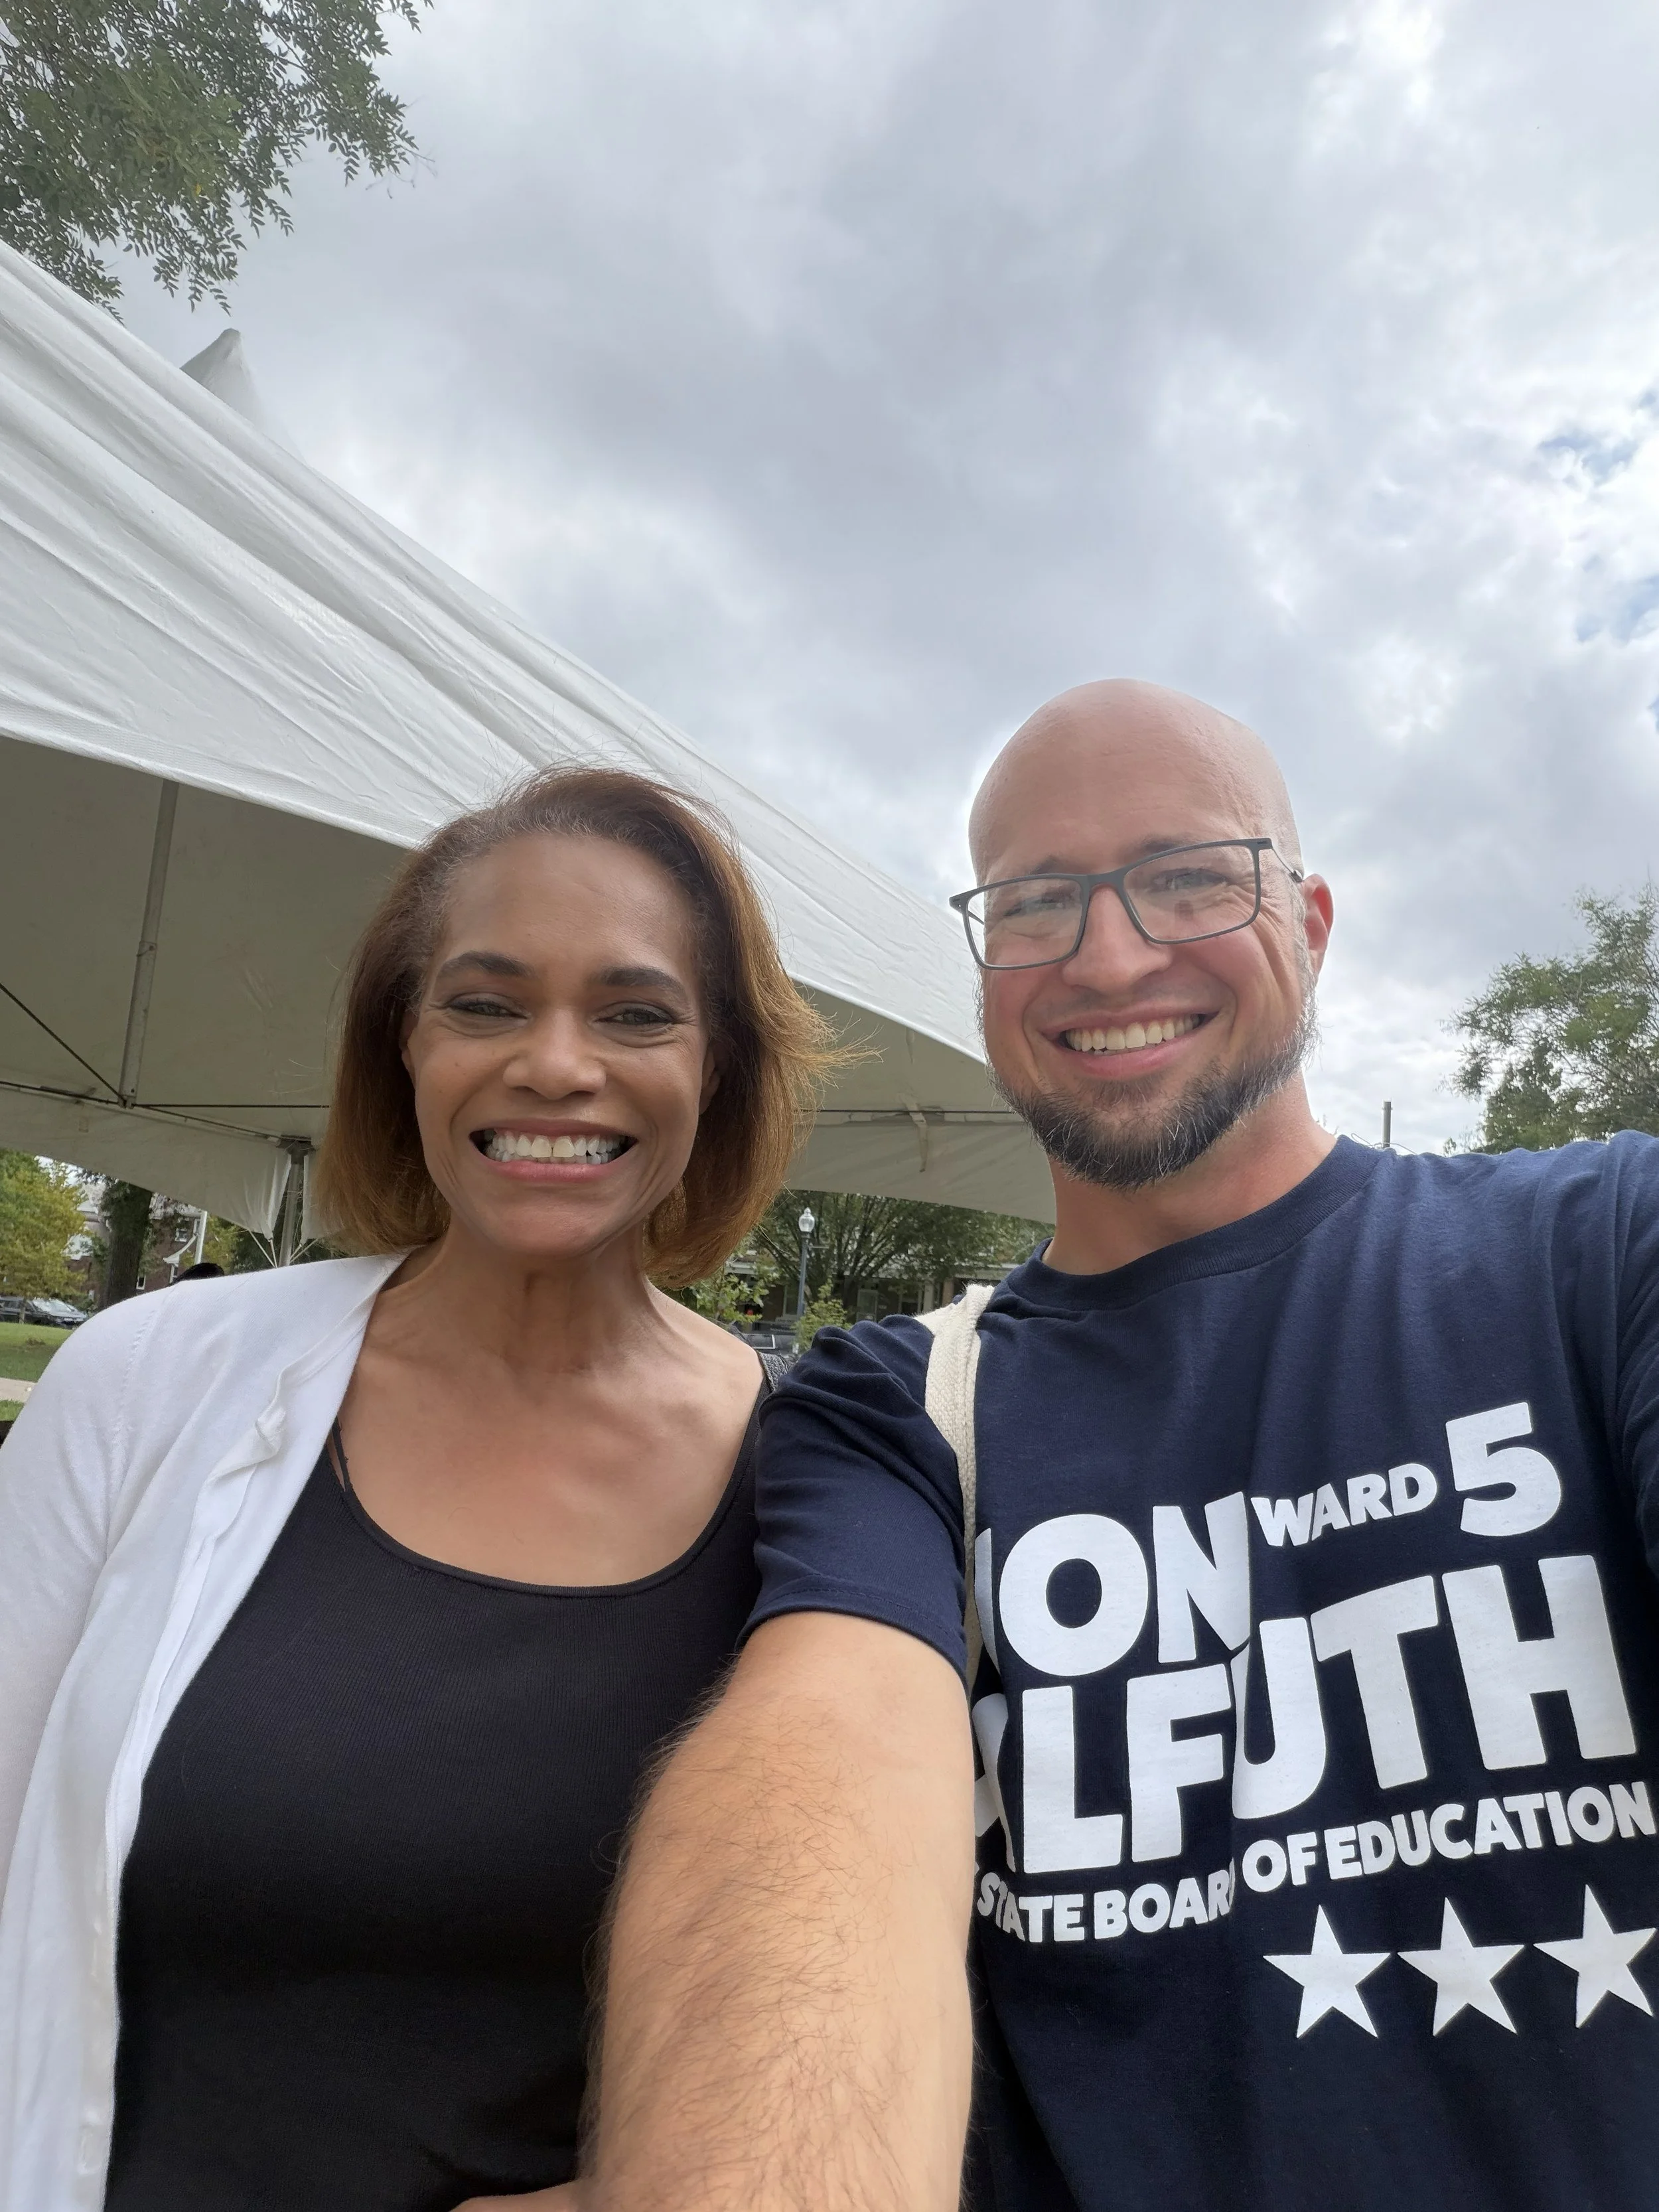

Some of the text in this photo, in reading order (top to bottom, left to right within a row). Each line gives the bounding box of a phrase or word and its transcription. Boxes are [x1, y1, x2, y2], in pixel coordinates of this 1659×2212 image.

[1250, 1402, 1561, 1547] WARD 5
[977, 1781, 1657, 1943] STATE BOAR OF EDUCATION
